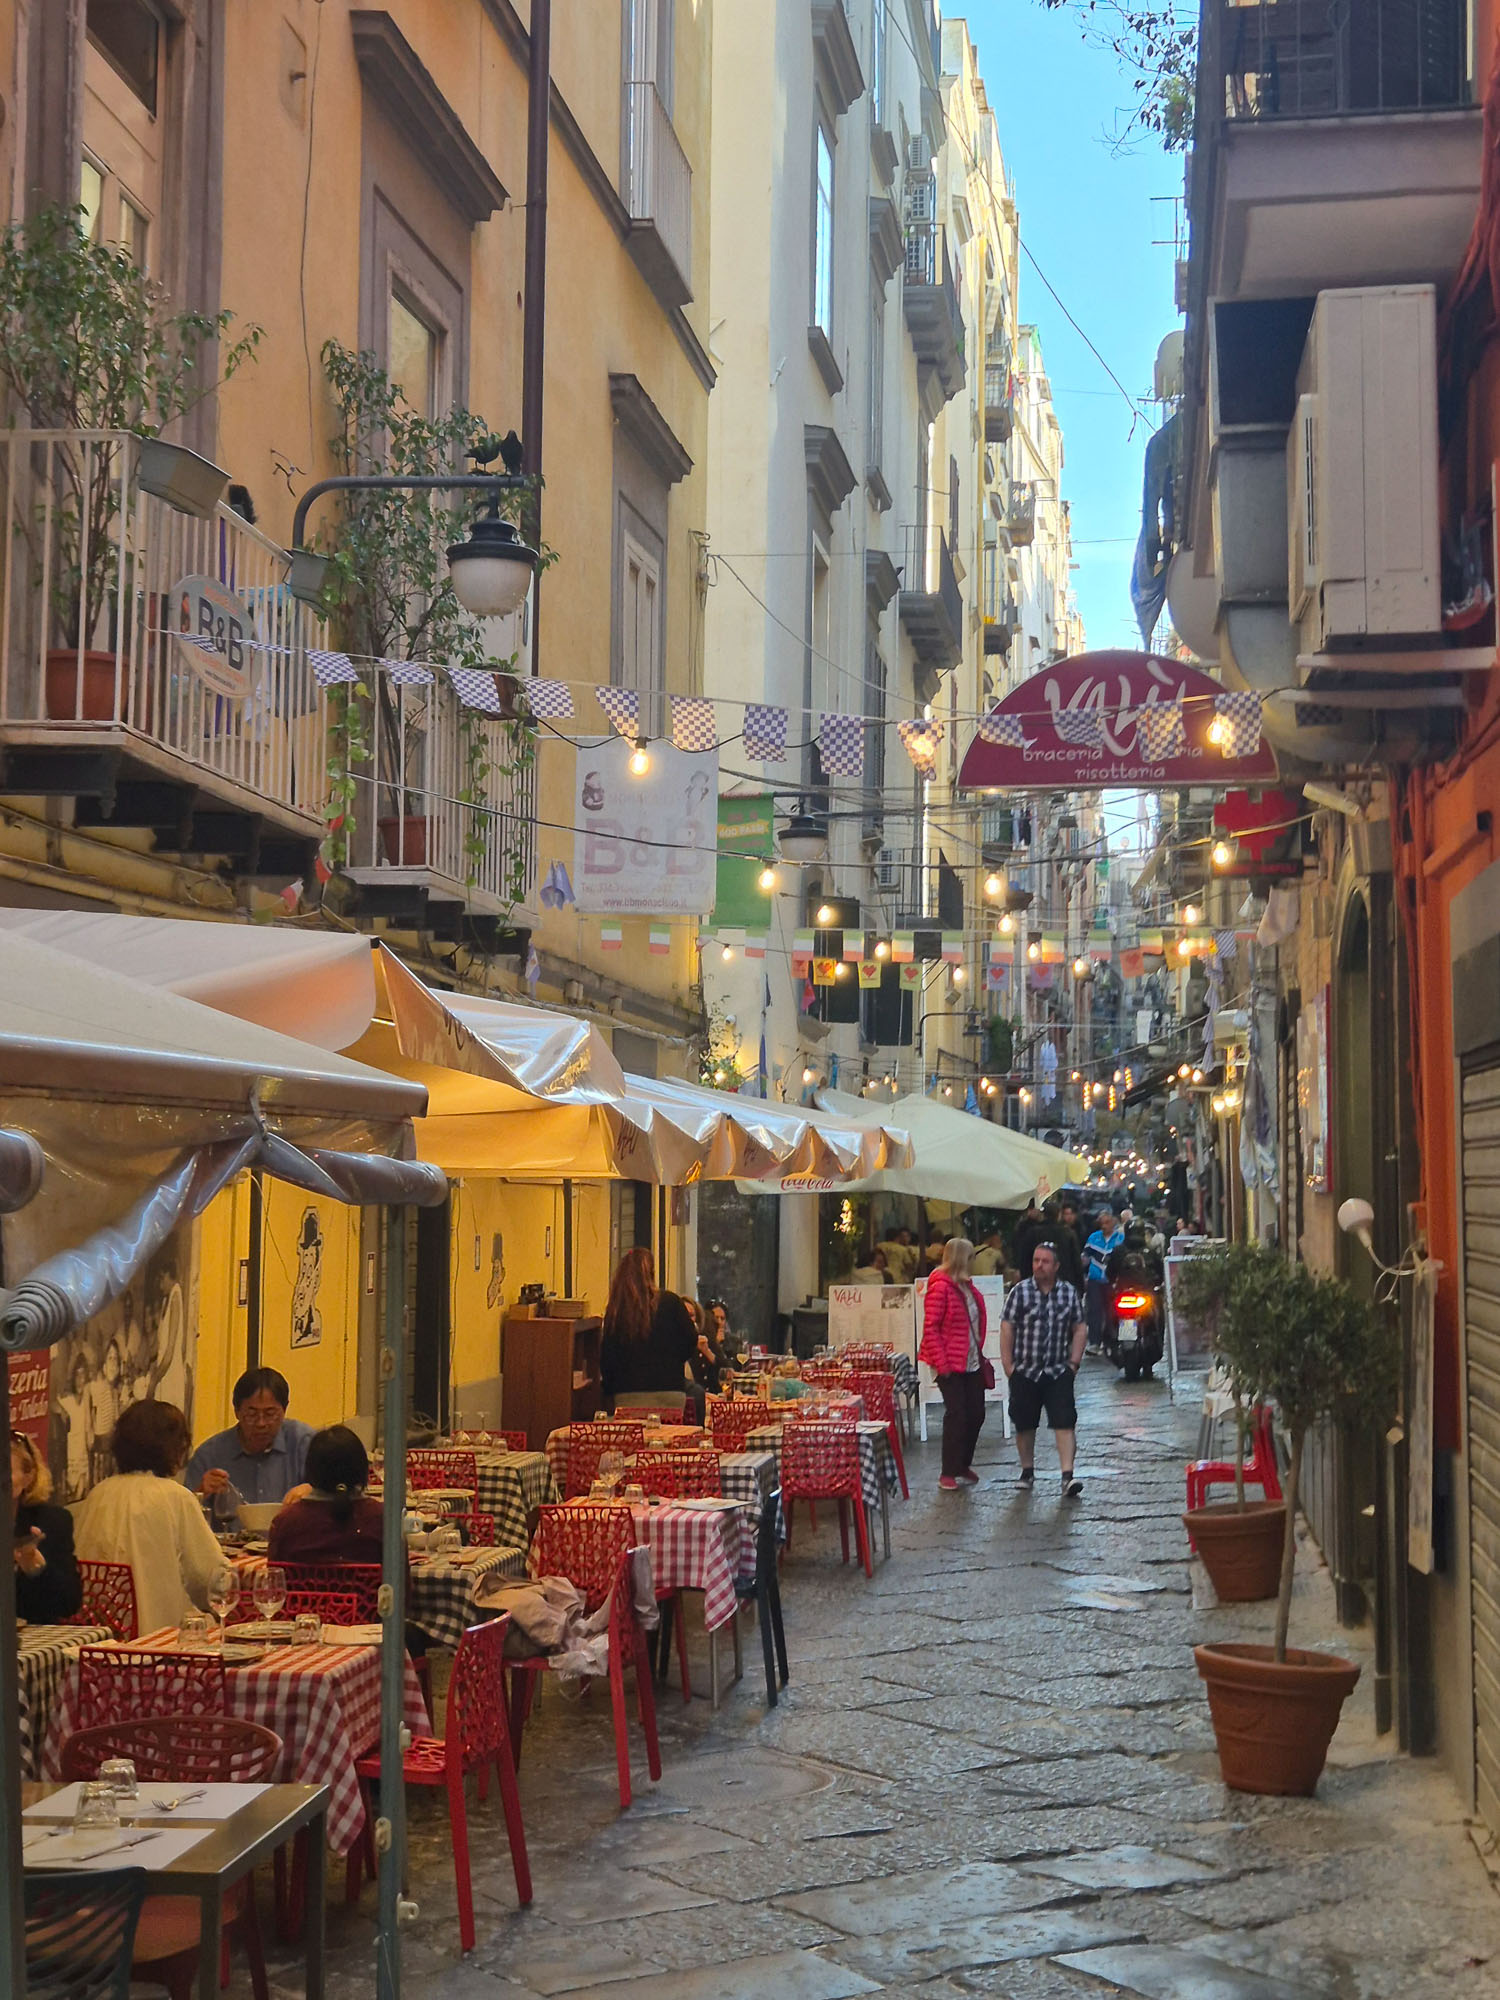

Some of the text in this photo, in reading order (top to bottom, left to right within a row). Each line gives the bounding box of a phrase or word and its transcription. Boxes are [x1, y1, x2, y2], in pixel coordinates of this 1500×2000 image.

[198, 596, 244, 671] B&B
[1022, 743, 1104, 762] braceria
[1075, 762, 1167, 781] risotteria
[584, 818, 705, 875] B&B
